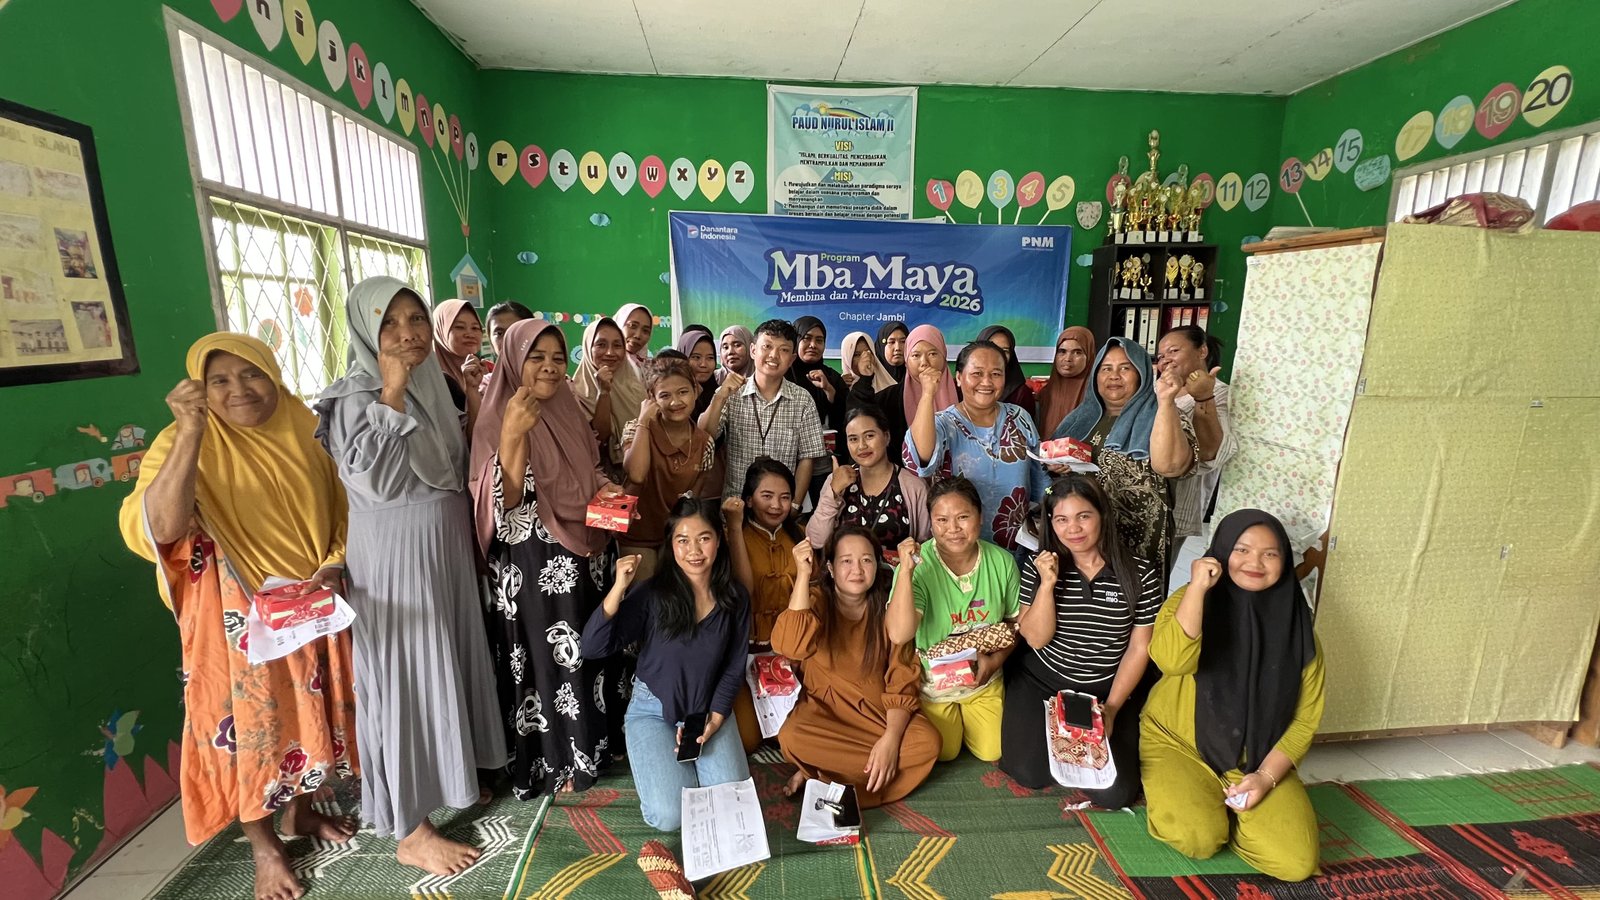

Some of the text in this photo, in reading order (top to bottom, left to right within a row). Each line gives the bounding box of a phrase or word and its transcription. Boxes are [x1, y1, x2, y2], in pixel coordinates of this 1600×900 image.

[294, 9, 304, 37] i
[328, 40, 337, 62] j
[355, 58, 365, 81] k
[401, 92, 409, 113] m
[421, 109, 430, 128] n
[438, 119, 444, 135] o
[453, 126, 460, 142] p
[470, 142, 476, 158] q
[792, 116, 818, 129] PAUD
[855, 118, 885, 132] ISLAM
[887, 119, 894, 132] II
[1281, 162, 1303, 188] 13
[1305, 151, 1331, 175] 14
[1338, 136, 1361, 163] 15
[1441, 104, 1473, 136] 18
[1480, 90, 1518, 128] 19
[1523, 73, 1572, 113] 20
[835, 141, 852, 151] VISI
[496, 153, 745, 183] r s t u v w x y z
[834, 171, 852, 181] MISI
[932, 182, 947, 204] 1
[960, 178, 978, 200] 2
[992, 176, 1009, 200] 3
[1020, 179, 1040, 200] 4
[1052, 182, 1070, 203] 5
[1220, 181, 1237, 201] 11
[1247, 179, 1268, 201] 12
[700, 224, 738, 234] Danantara
[700, 232, 736, 240] Indonesia
[1021, 236, 1054, 248] PNM
[821, 253, 860, 264] Program
[770, 250, 978, 304] Mba Maya
[780, 289, 922, 303] Membina dan Memberdaya
[939, 293, 981, 312] 2026
[839, 311, 906, 323] Chapter Jambi
[951, 608, 990, 625] PLAY
